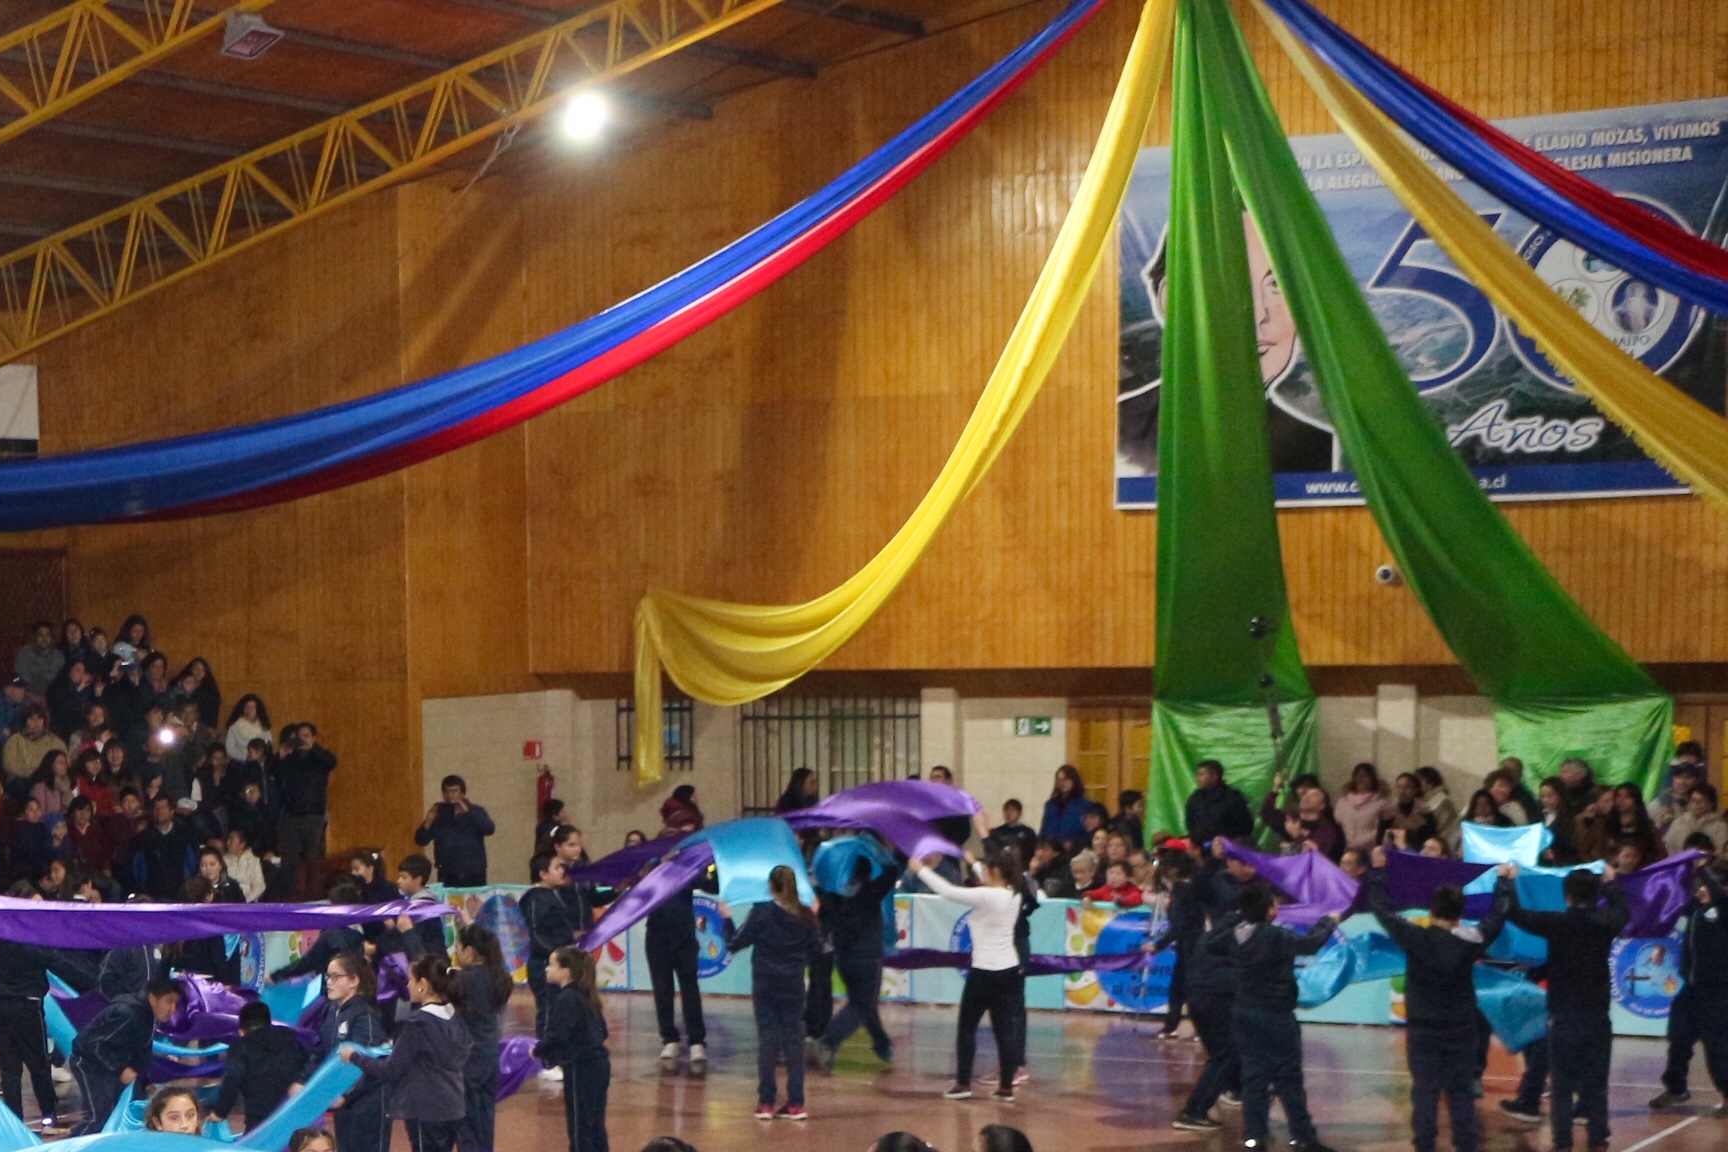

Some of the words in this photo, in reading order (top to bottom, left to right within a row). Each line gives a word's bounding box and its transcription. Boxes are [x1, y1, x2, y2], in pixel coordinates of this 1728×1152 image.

[1316, 153, 1332, 170] LA
[1534, 131, 1586, 151] ELADIO
[1653, 120, 1720, 141] VIVIMOS
[1606, 146, 1693, 168] MISIONERA
[1450, 400, 1603, 451] Años
